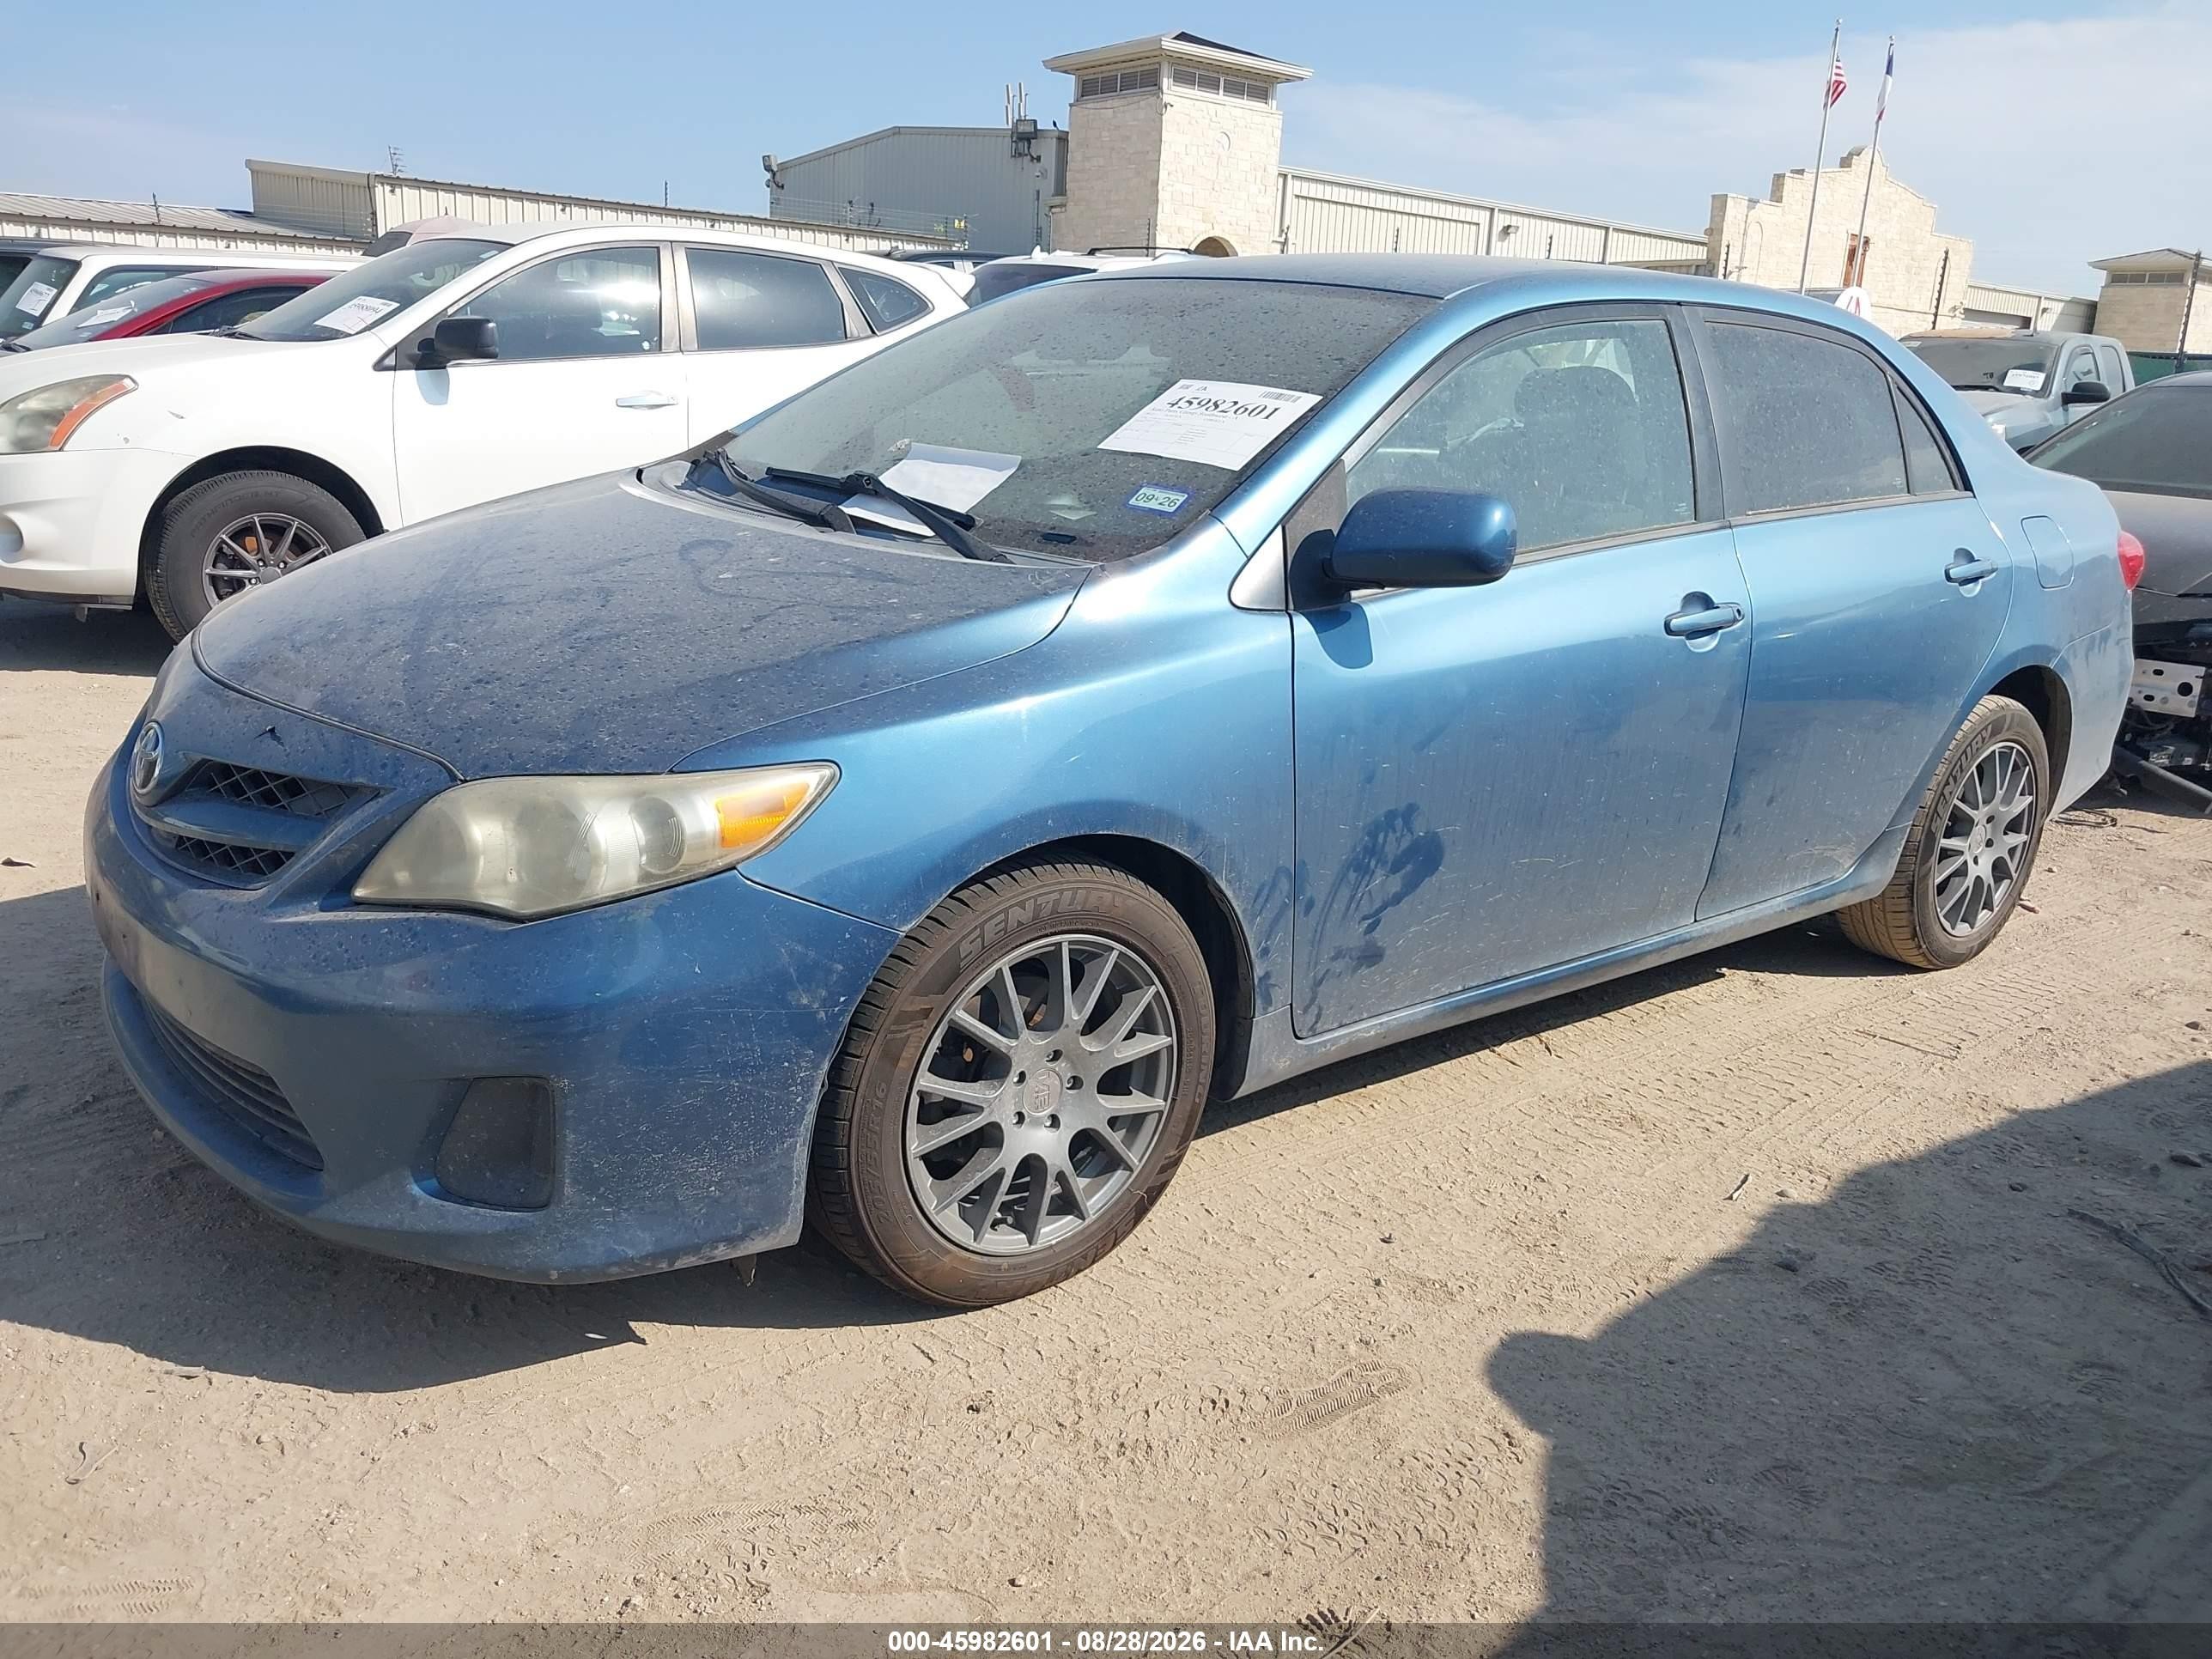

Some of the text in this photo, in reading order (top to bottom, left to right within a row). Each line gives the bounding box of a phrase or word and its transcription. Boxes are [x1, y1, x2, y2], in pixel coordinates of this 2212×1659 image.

[1166, 395, 1281, 419] 45982601
[1134, 492, 1180, 507] 09 26
[1930, 723, 1993, 837] SENTURY
